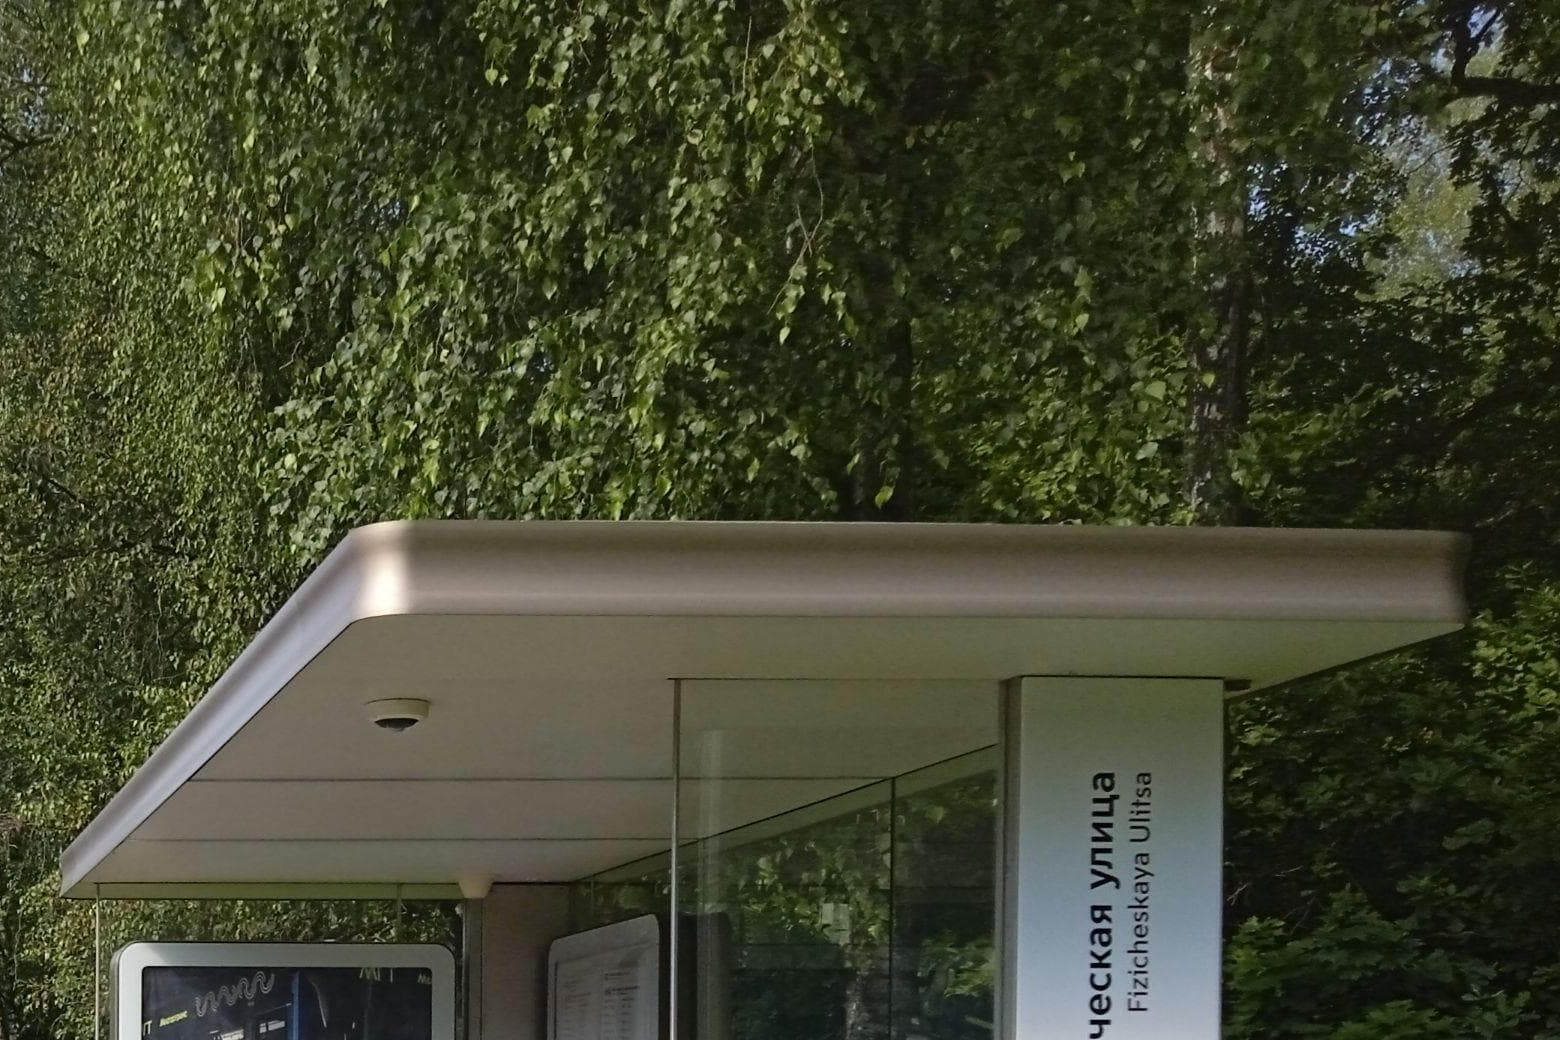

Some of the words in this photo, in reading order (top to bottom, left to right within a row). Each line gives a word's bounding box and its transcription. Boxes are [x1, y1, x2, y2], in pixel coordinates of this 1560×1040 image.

[1090, 772, 1120, 889] улица
[1128, 772, 1152, 843] Ulitsa
[1126, 852, 1155, 1012] Fizicheskaya
